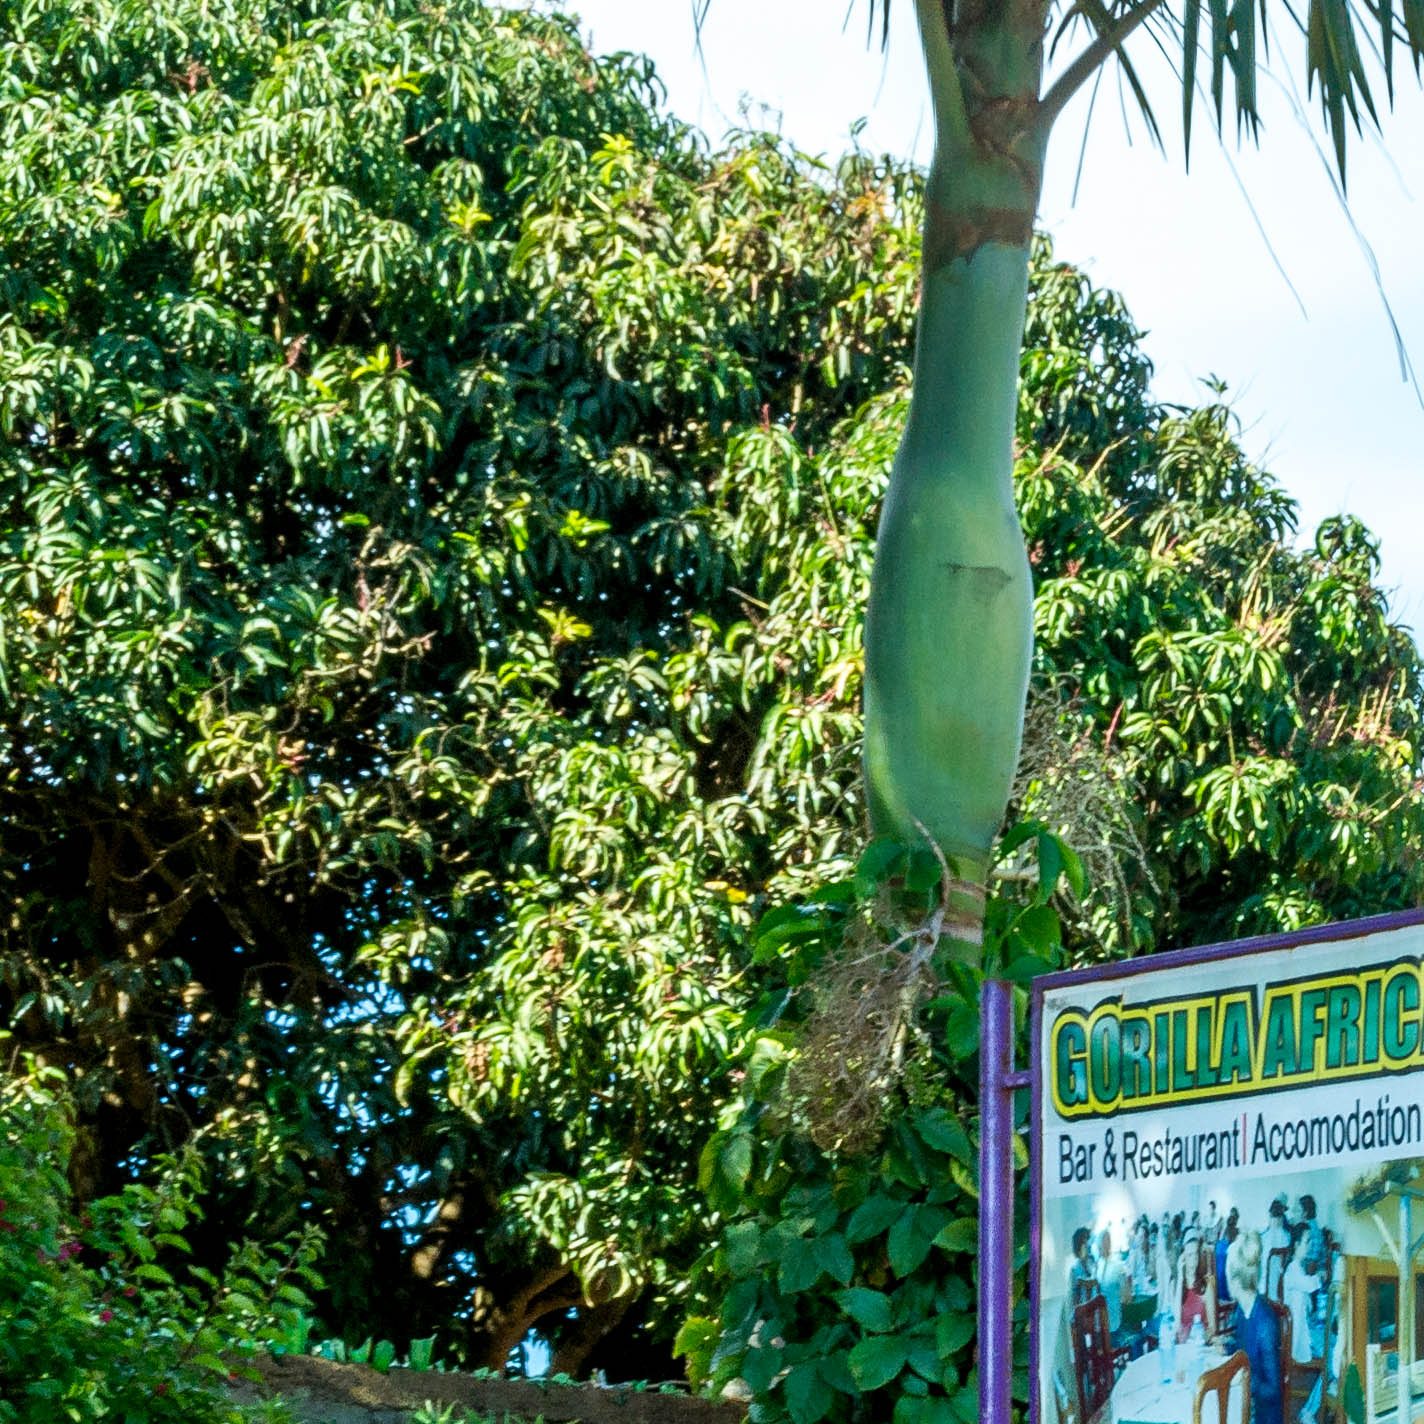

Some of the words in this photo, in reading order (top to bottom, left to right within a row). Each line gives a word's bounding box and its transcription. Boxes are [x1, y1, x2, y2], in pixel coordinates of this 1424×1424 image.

[1055, 998, 1254, 1108] GORILLA
[1058, 1133, 1097, 1184] Bar
[1102, 1126, 1118, 1178] &
[1122, 1115, 1241, 1182] Restaurant
[1251, 1095, 1422, 1165] Accomodation
